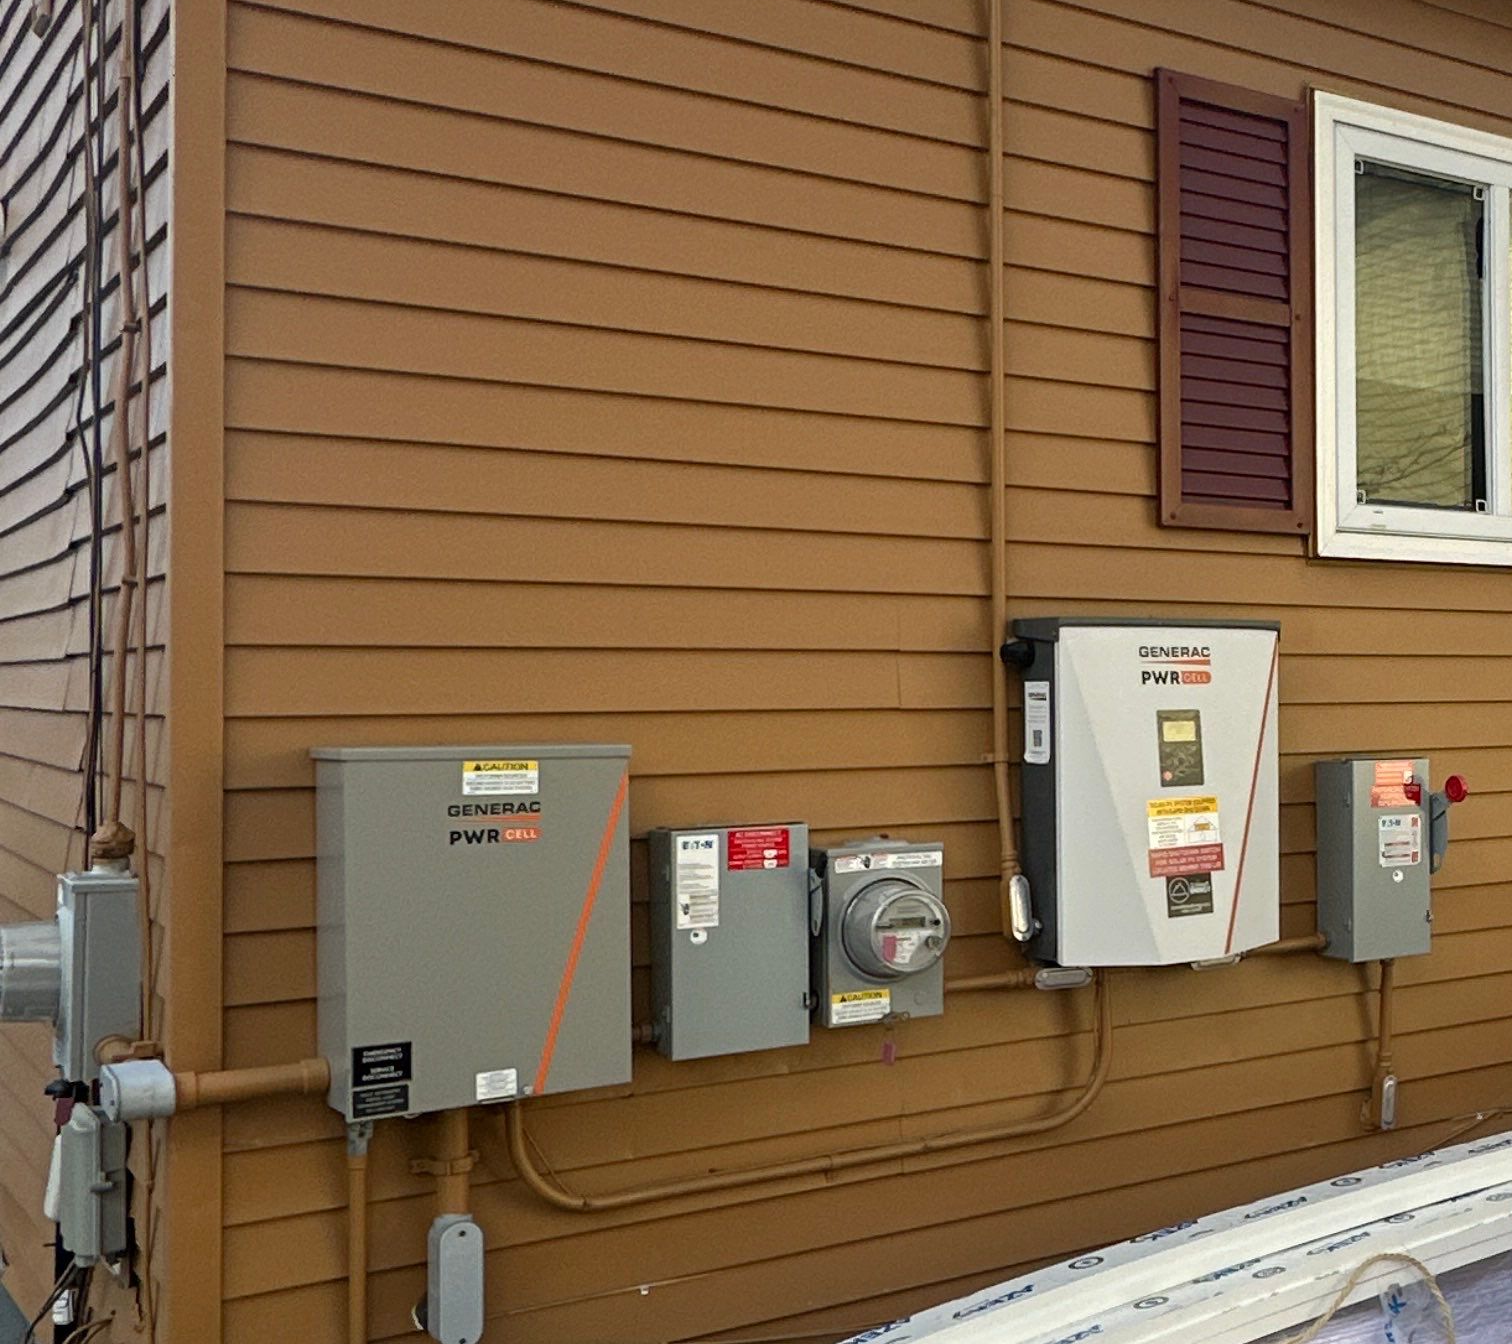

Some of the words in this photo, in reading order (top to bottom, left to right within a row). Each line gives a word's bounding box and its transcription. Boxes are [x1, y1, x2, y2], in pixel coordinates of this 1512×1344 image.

[1138, 645, 1211, 658] GENERAC
[482, 762, 529, 772] CAUTION
[447, 801, 541, 817] GENERAC
